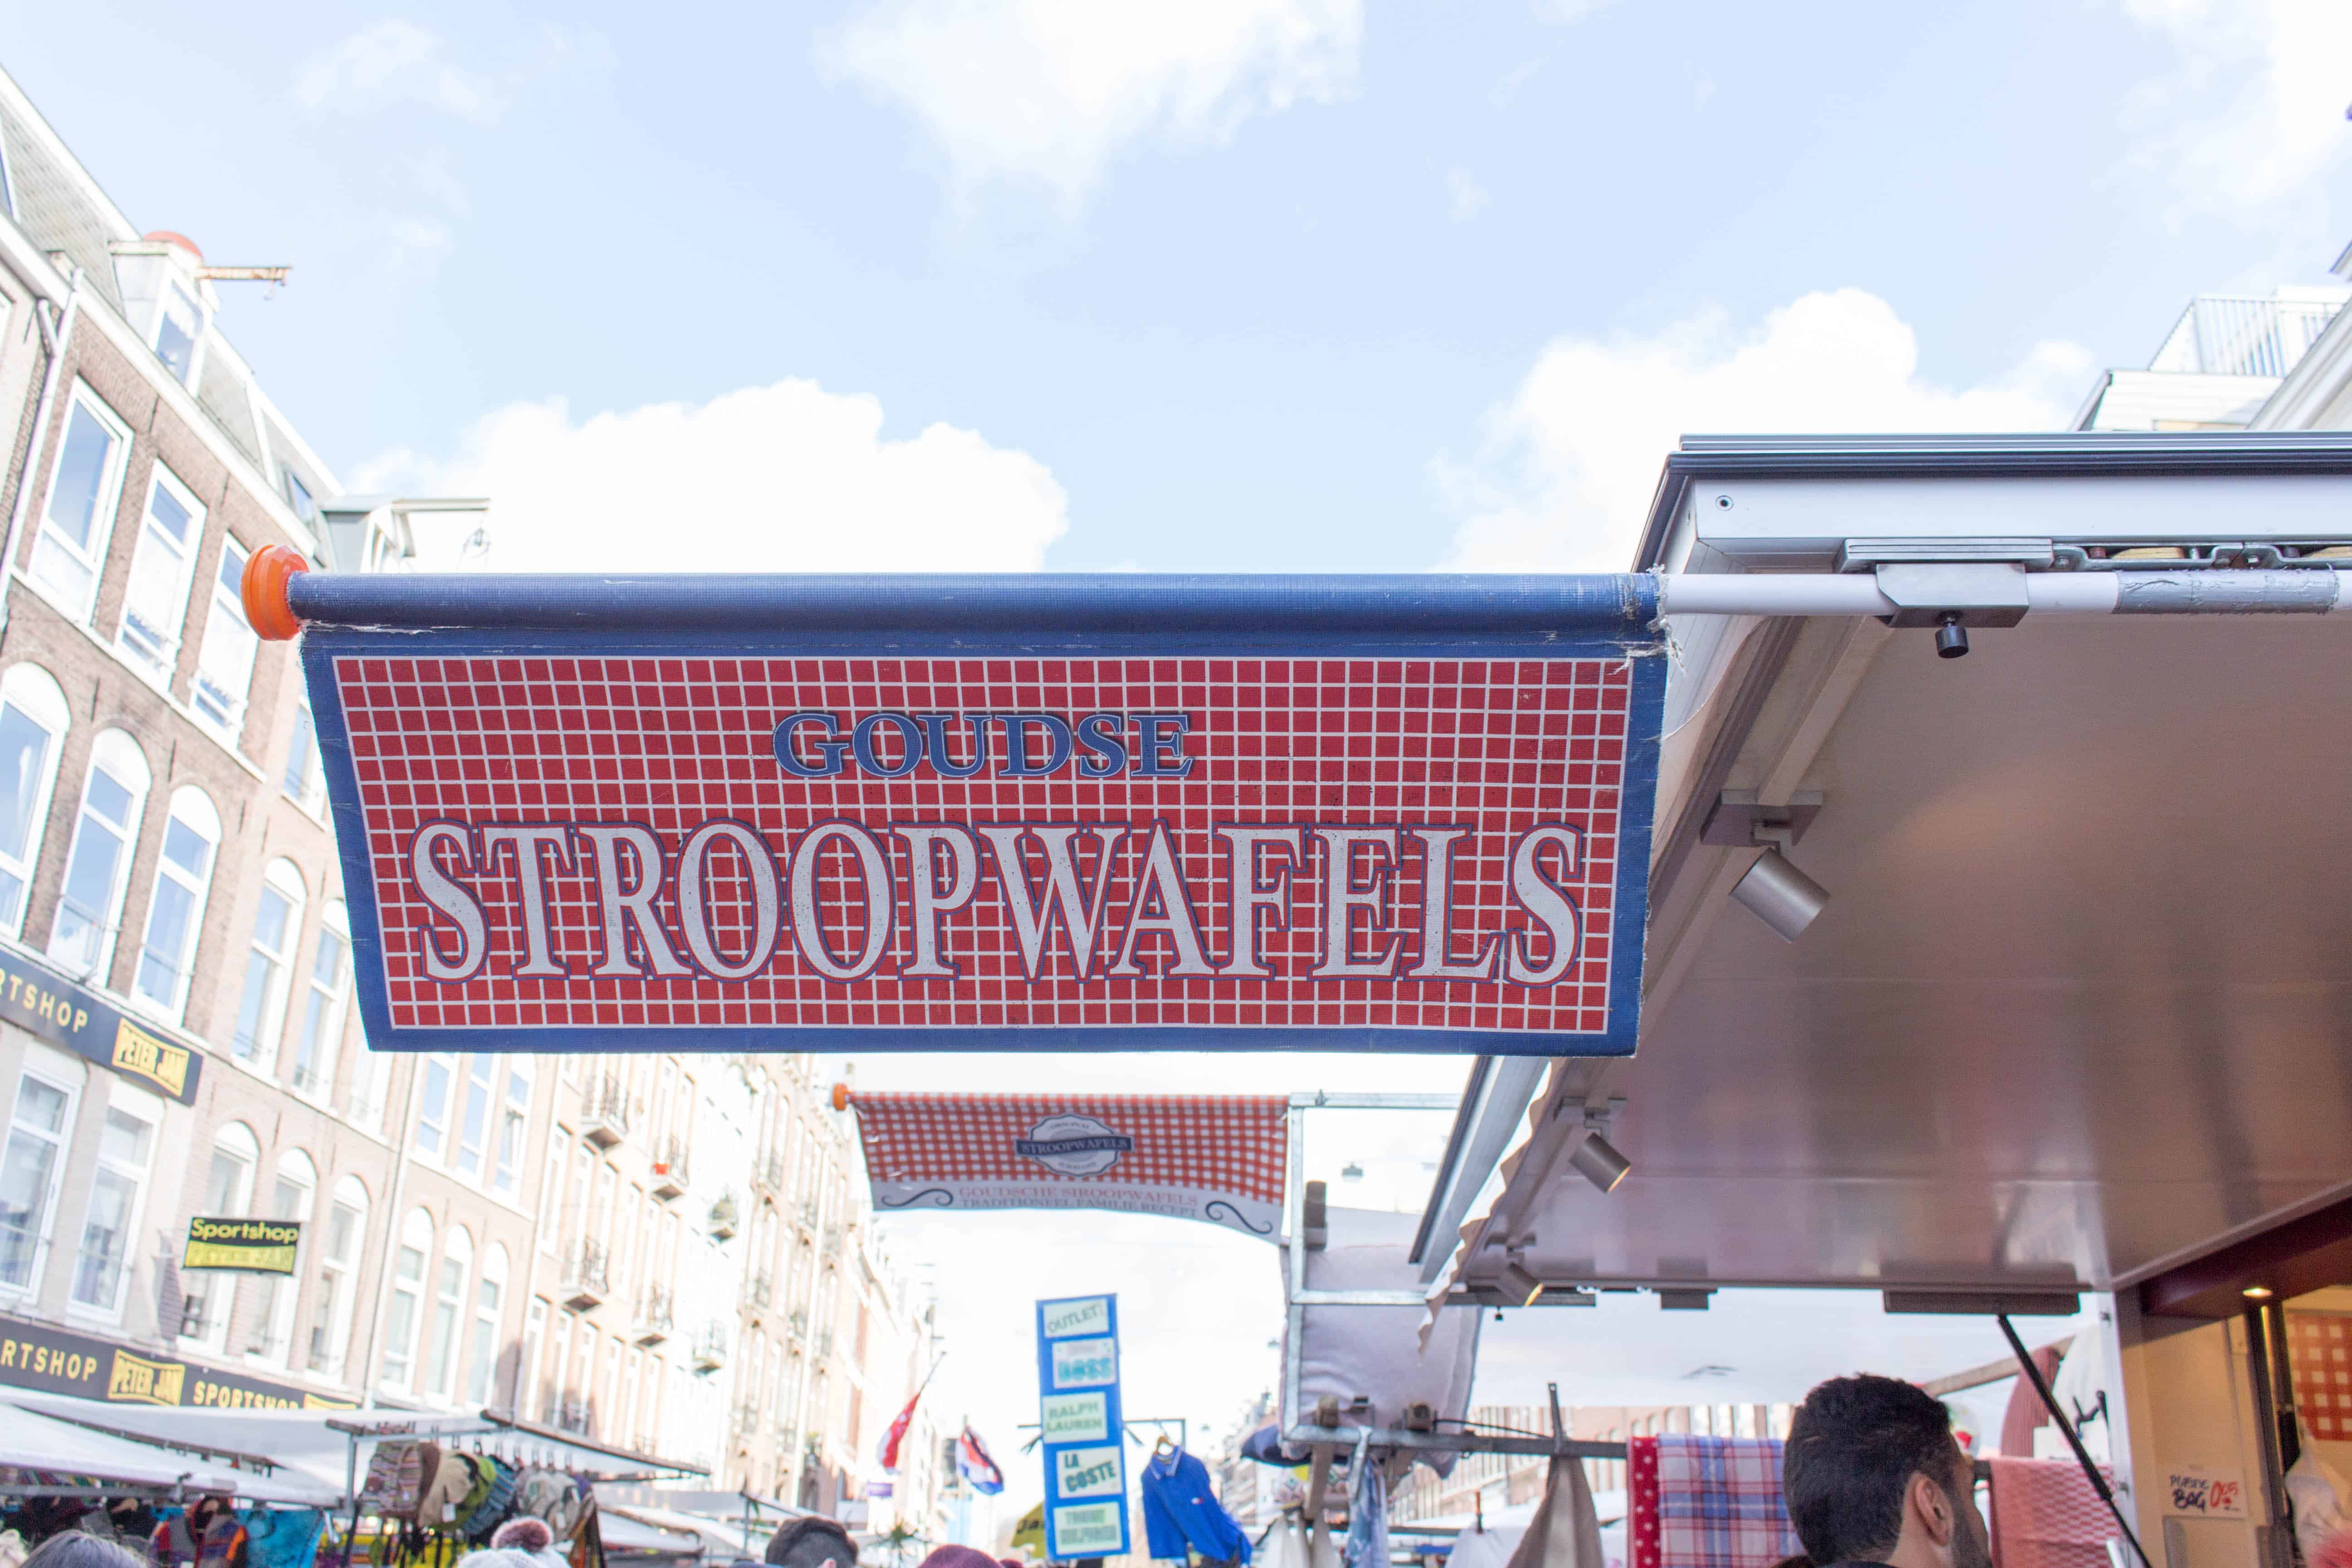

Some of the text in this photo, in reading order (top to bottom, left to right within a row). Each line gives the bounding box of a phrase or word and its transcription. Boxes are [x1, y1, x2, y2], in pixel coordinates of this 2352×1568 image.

[772, 711, 1194, 777] GOUDSE
[407, 817, 1583, 988] STROOPWAFELS
[120, 1028, 187, 1090] PETER JAN
[1021, 1137, 1128, 1155] STROOPWAFELS
[190, 1218, 299, 1245] Sportshop
[1, 1338, 97, 1382] RTSHOP
[113, 1356, 182, 1405] PETER JAN
[1064, 1453, 1079, 1469] LA
[1065, 1460, 1117, 1492] COSTE
